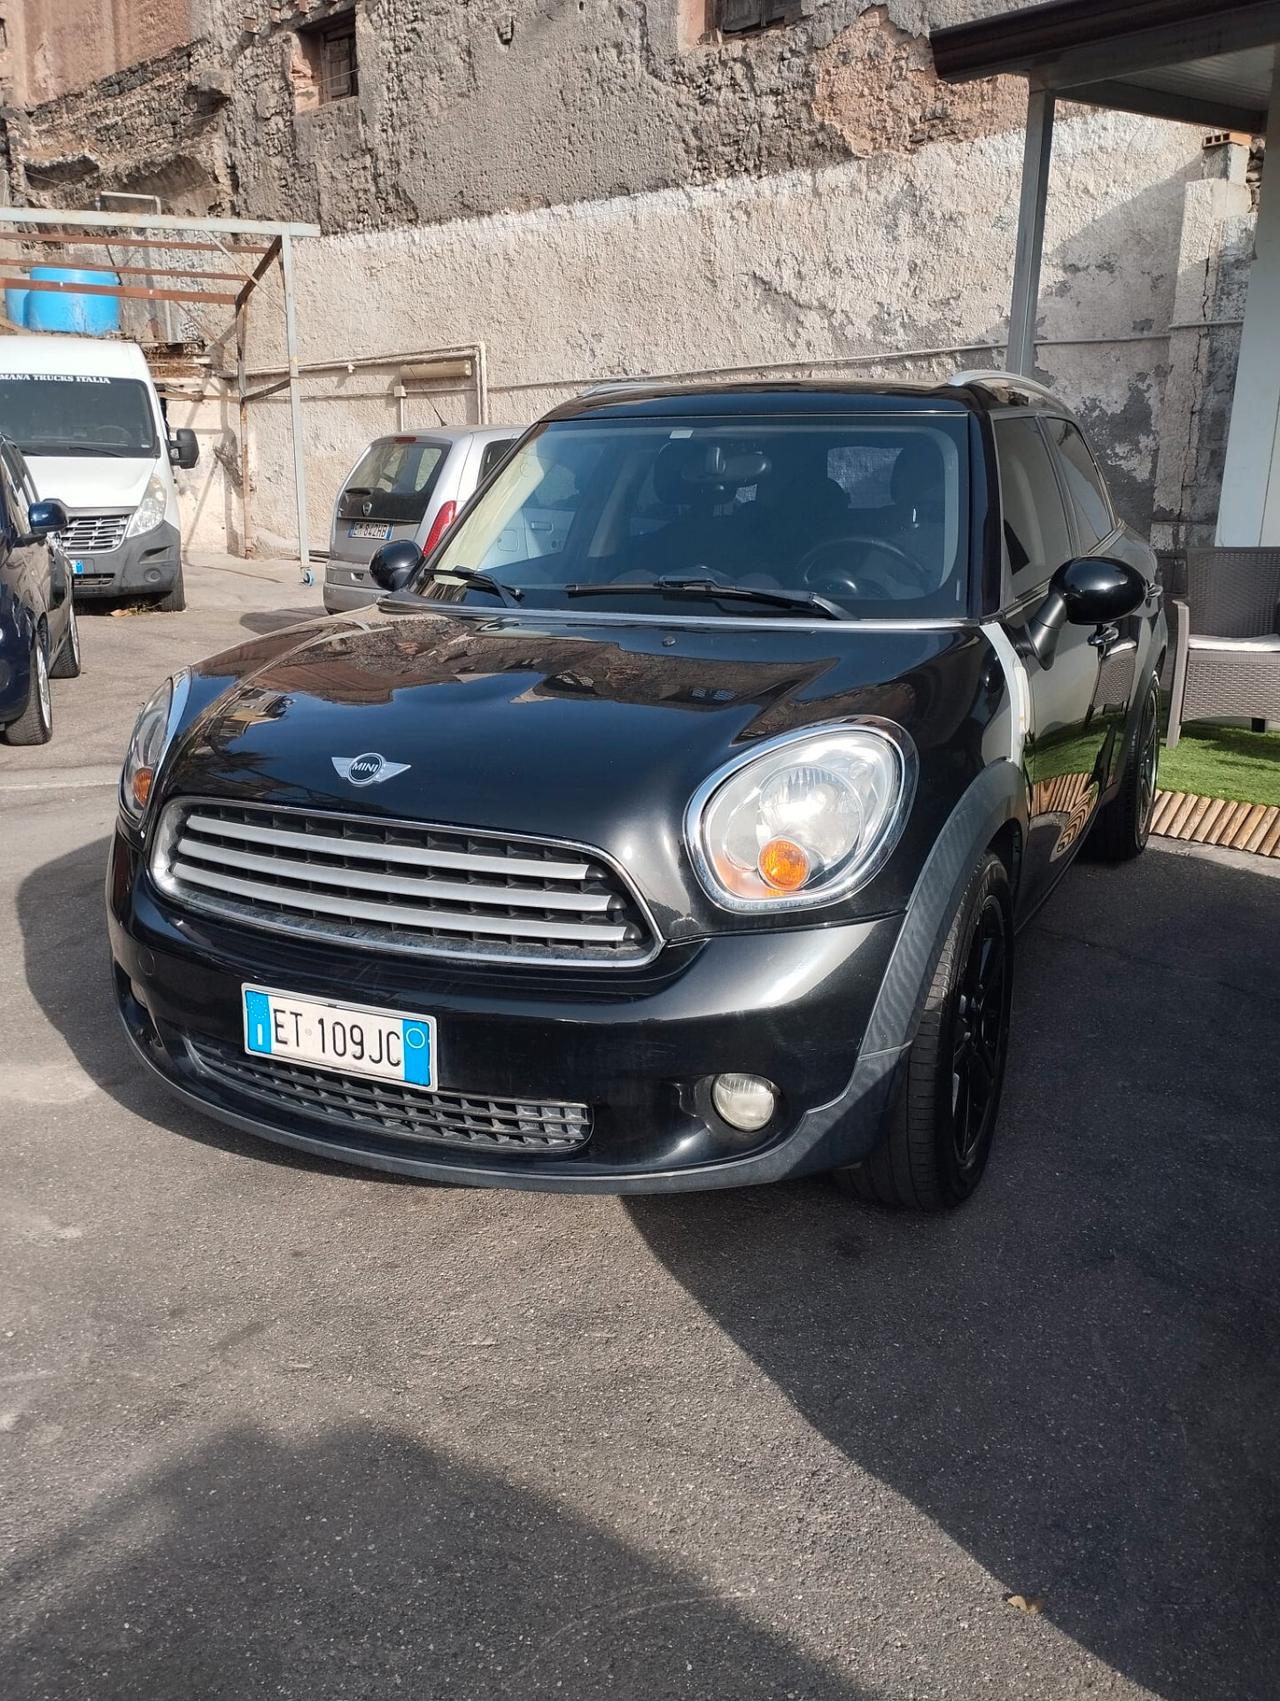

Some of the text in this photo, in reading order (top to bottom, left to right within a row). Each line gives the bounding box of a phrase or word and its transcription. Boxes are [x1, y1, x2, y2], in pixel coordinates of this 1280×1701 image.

[32, 374, 74, 383] TRUCKS
[76, 376, 111, 384] ITALIA
[351, 762, 379, 773] MINI
[273, 1008, 303, 1048] ET
[317, 1017, 402, 1067] 109JC
